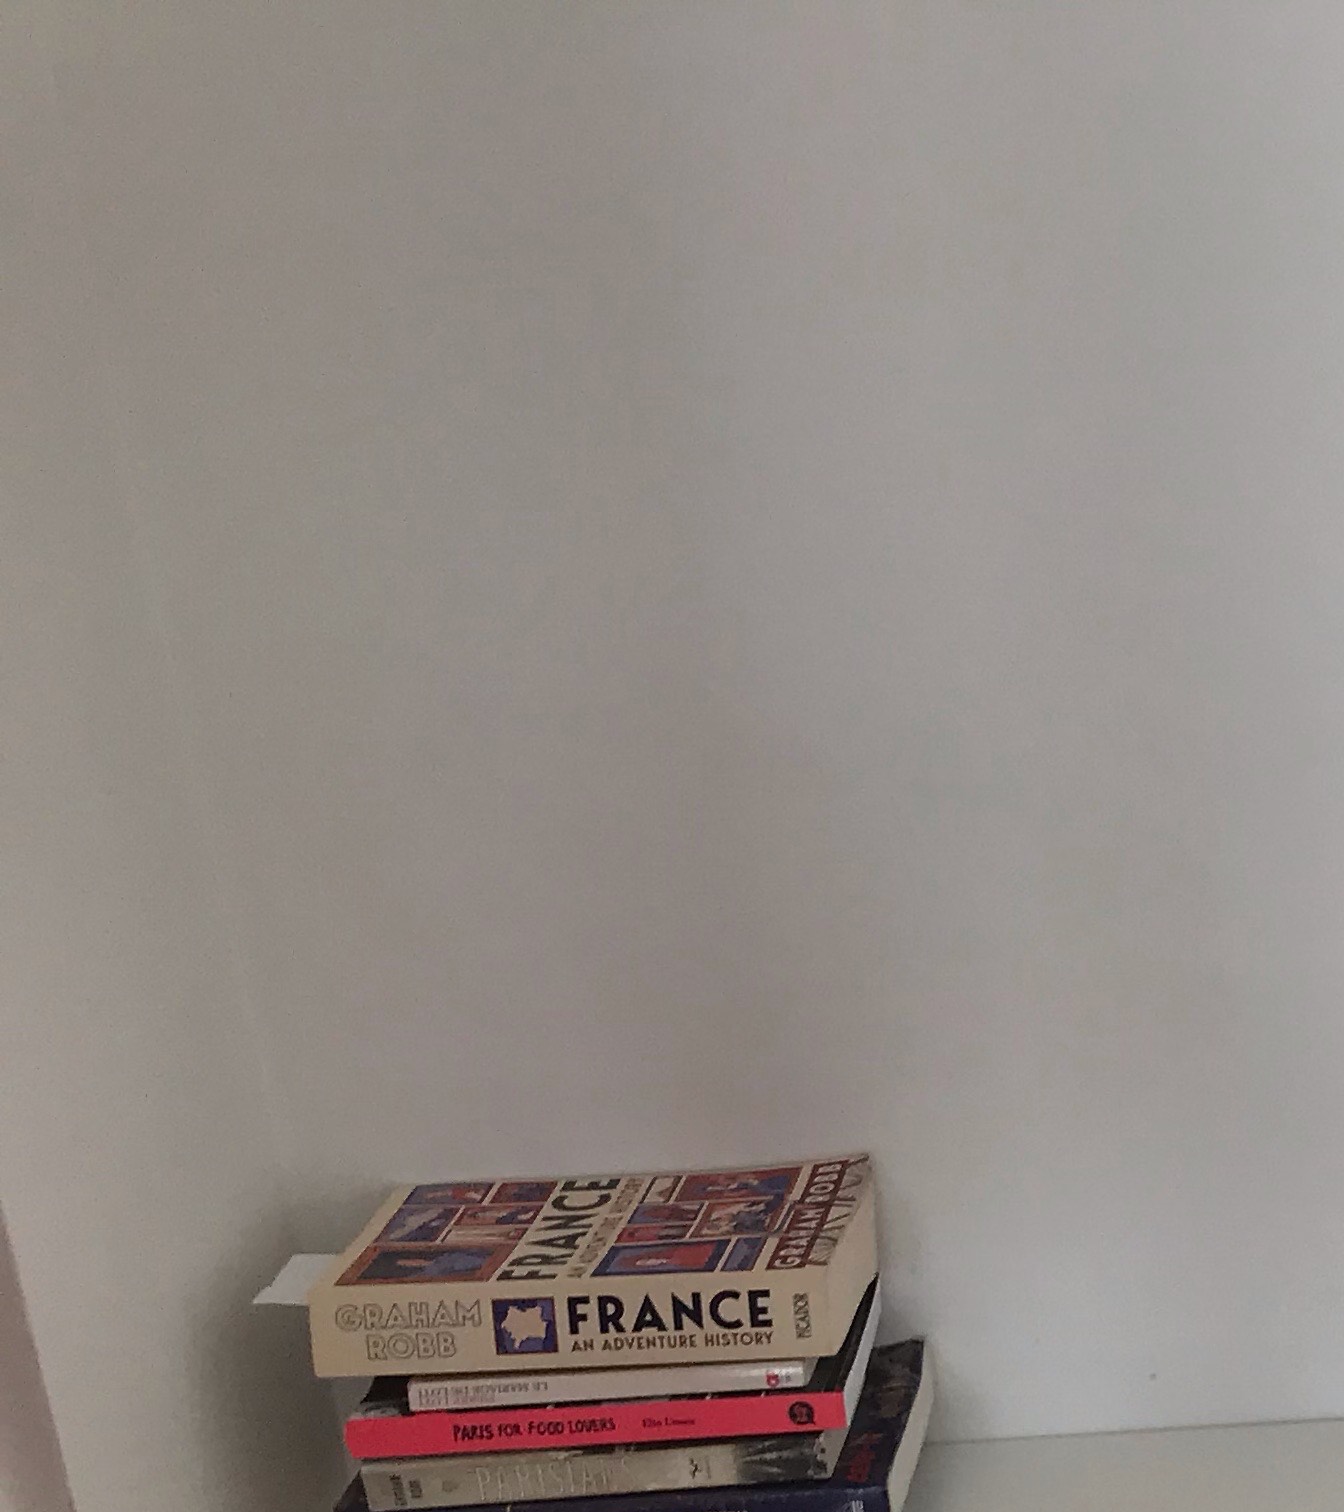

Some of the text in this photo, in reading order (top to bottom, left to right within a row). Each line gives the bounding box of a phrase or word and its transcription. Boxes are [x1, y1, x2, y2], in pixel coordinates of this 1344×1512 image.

[496, 1178, 621, 1281] FRANCE
[334, 1299, 482, 1331] GRAHAM
[566, 1289, 774, 1335] FRANCE
[366, 1331, 457, 1361] ROBB
[571, 1330, 775, 1352] AN ADVENTURE HISTORY
[453, 1417, 616, 1442] PARIS FOR FOOD LOVERS
